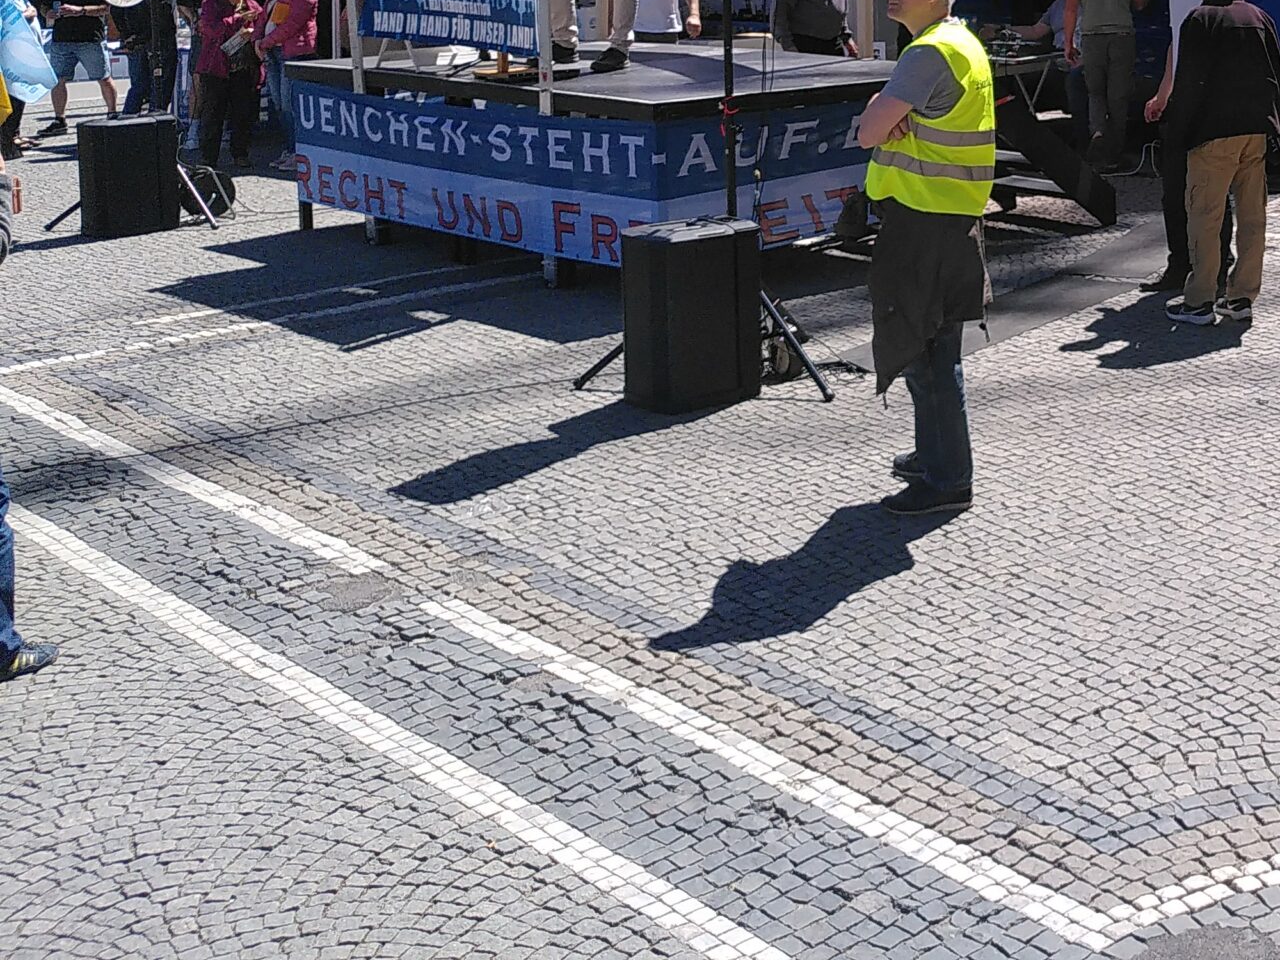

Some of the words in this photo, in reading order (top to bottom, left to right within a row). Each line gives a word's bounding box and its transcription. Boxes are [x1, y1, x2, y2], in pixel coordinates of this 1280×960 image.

[374, 11, 403, 33] HAND
[406, 13, 418, 34] IN
[420, 14, 450, 38] HAND
[451, 15, 470, 40] FÜR
[473, 20, 505, 45] UNSER
[506, 24, 534, 49] LAND!
[295, 154, 408, 220] RECHT
[432, 188, 523, 244] UND
